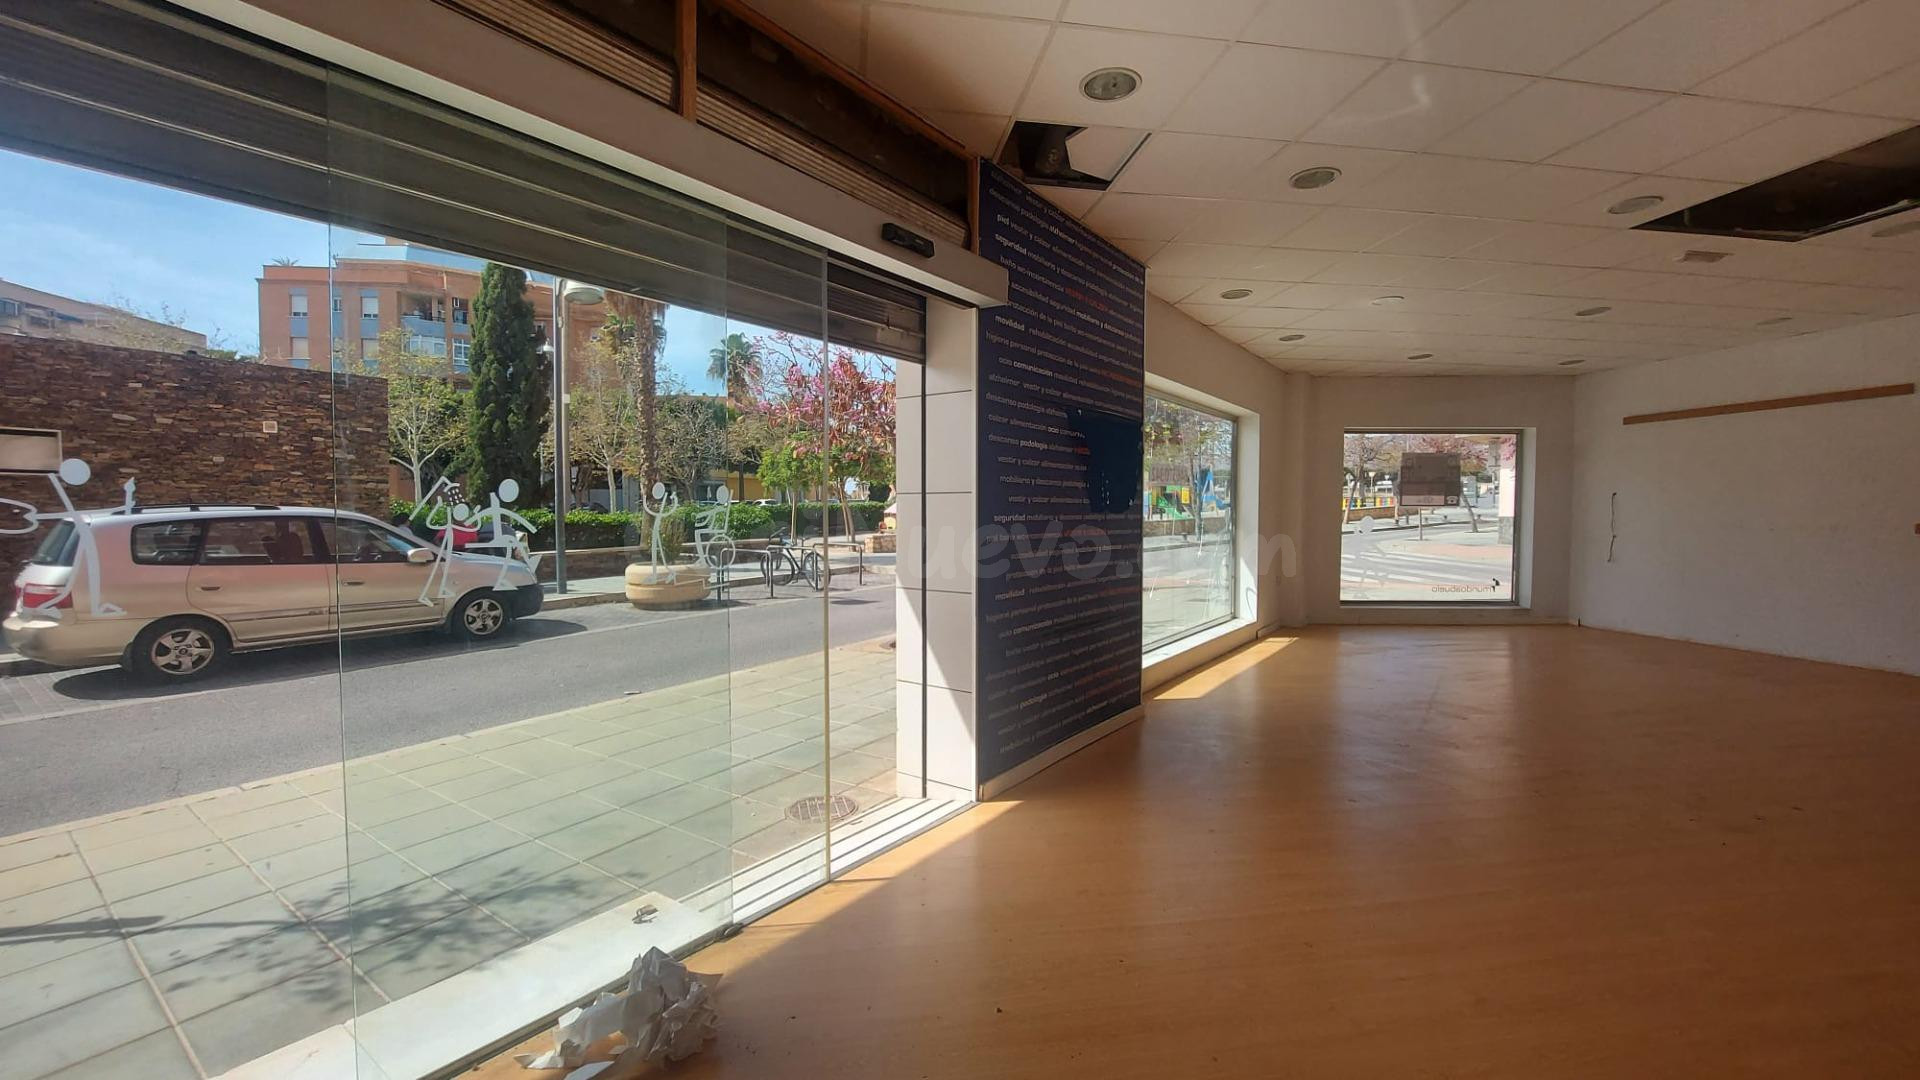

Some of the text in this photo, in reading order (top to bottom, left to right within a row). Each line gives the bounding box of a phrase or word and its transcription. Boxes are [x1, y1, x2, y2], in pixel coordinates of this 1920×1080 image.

[994, 232, 1026, 255] seguridad
[994, 314, 1024, 332] movilidad
[993, 512, 1025, 524] seguridad
